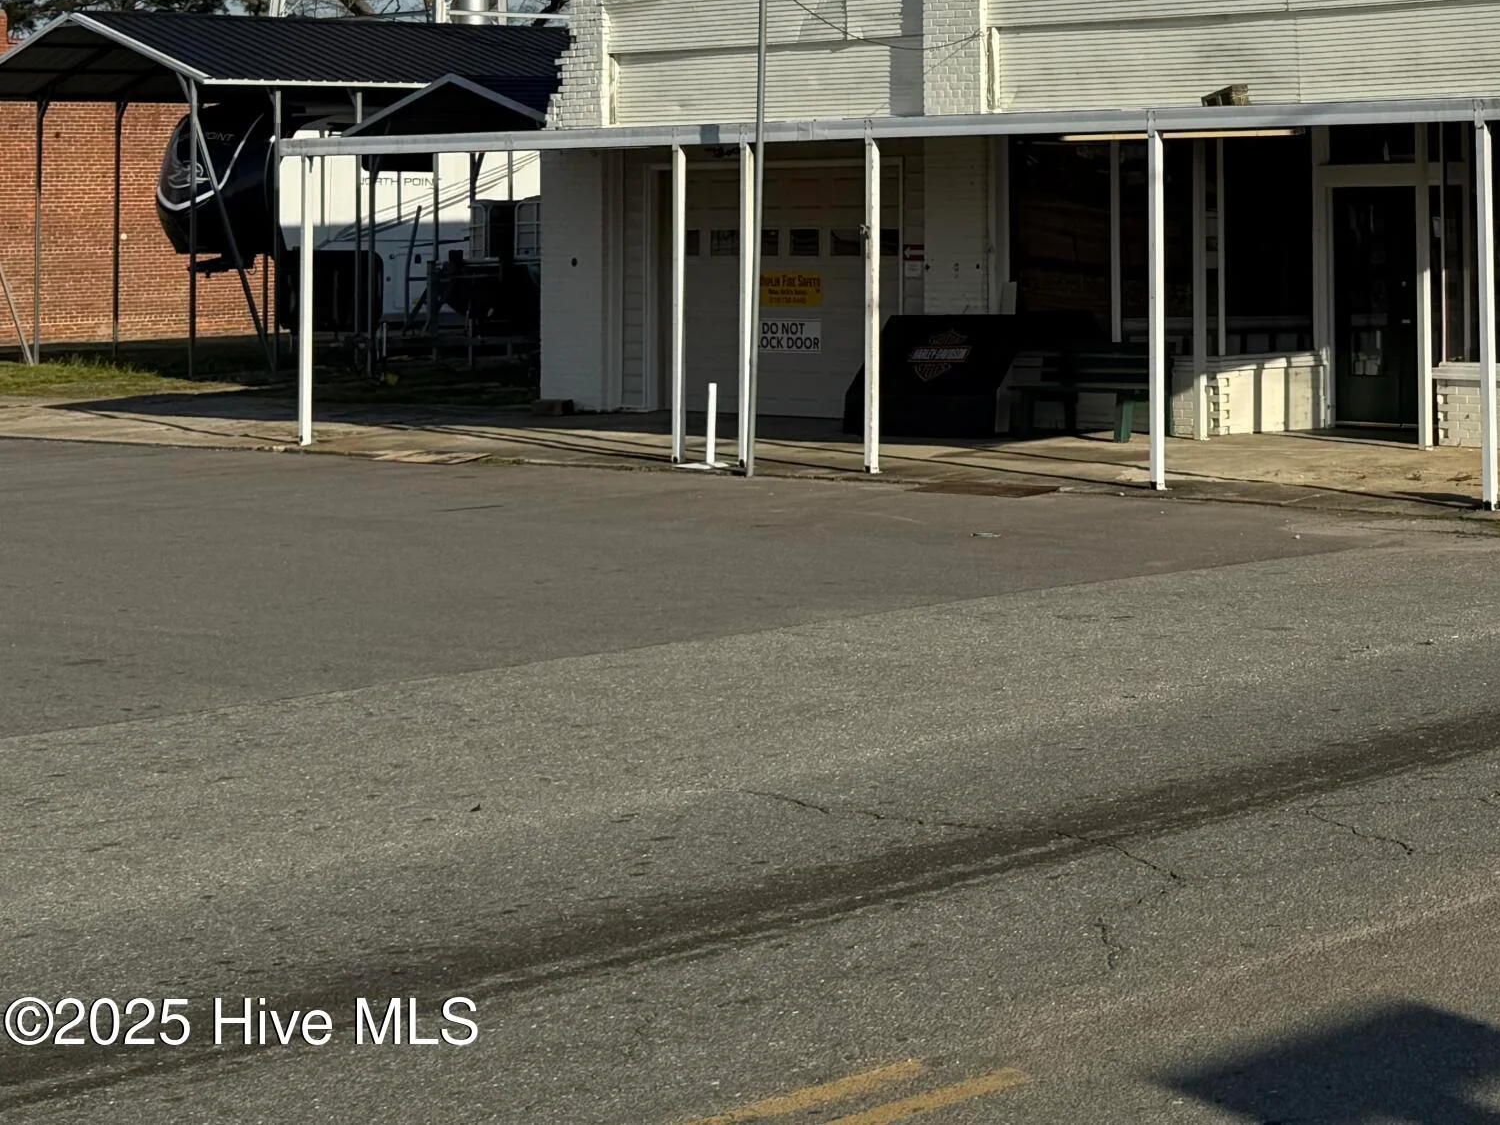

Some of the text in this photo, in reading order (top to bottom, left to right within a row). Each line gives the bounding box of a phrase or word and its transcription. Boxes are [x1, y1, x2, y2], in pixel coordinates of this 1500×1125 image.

[762, 322, 805, 336] DO NOT
[787, 337, 820, 350] DOOR
